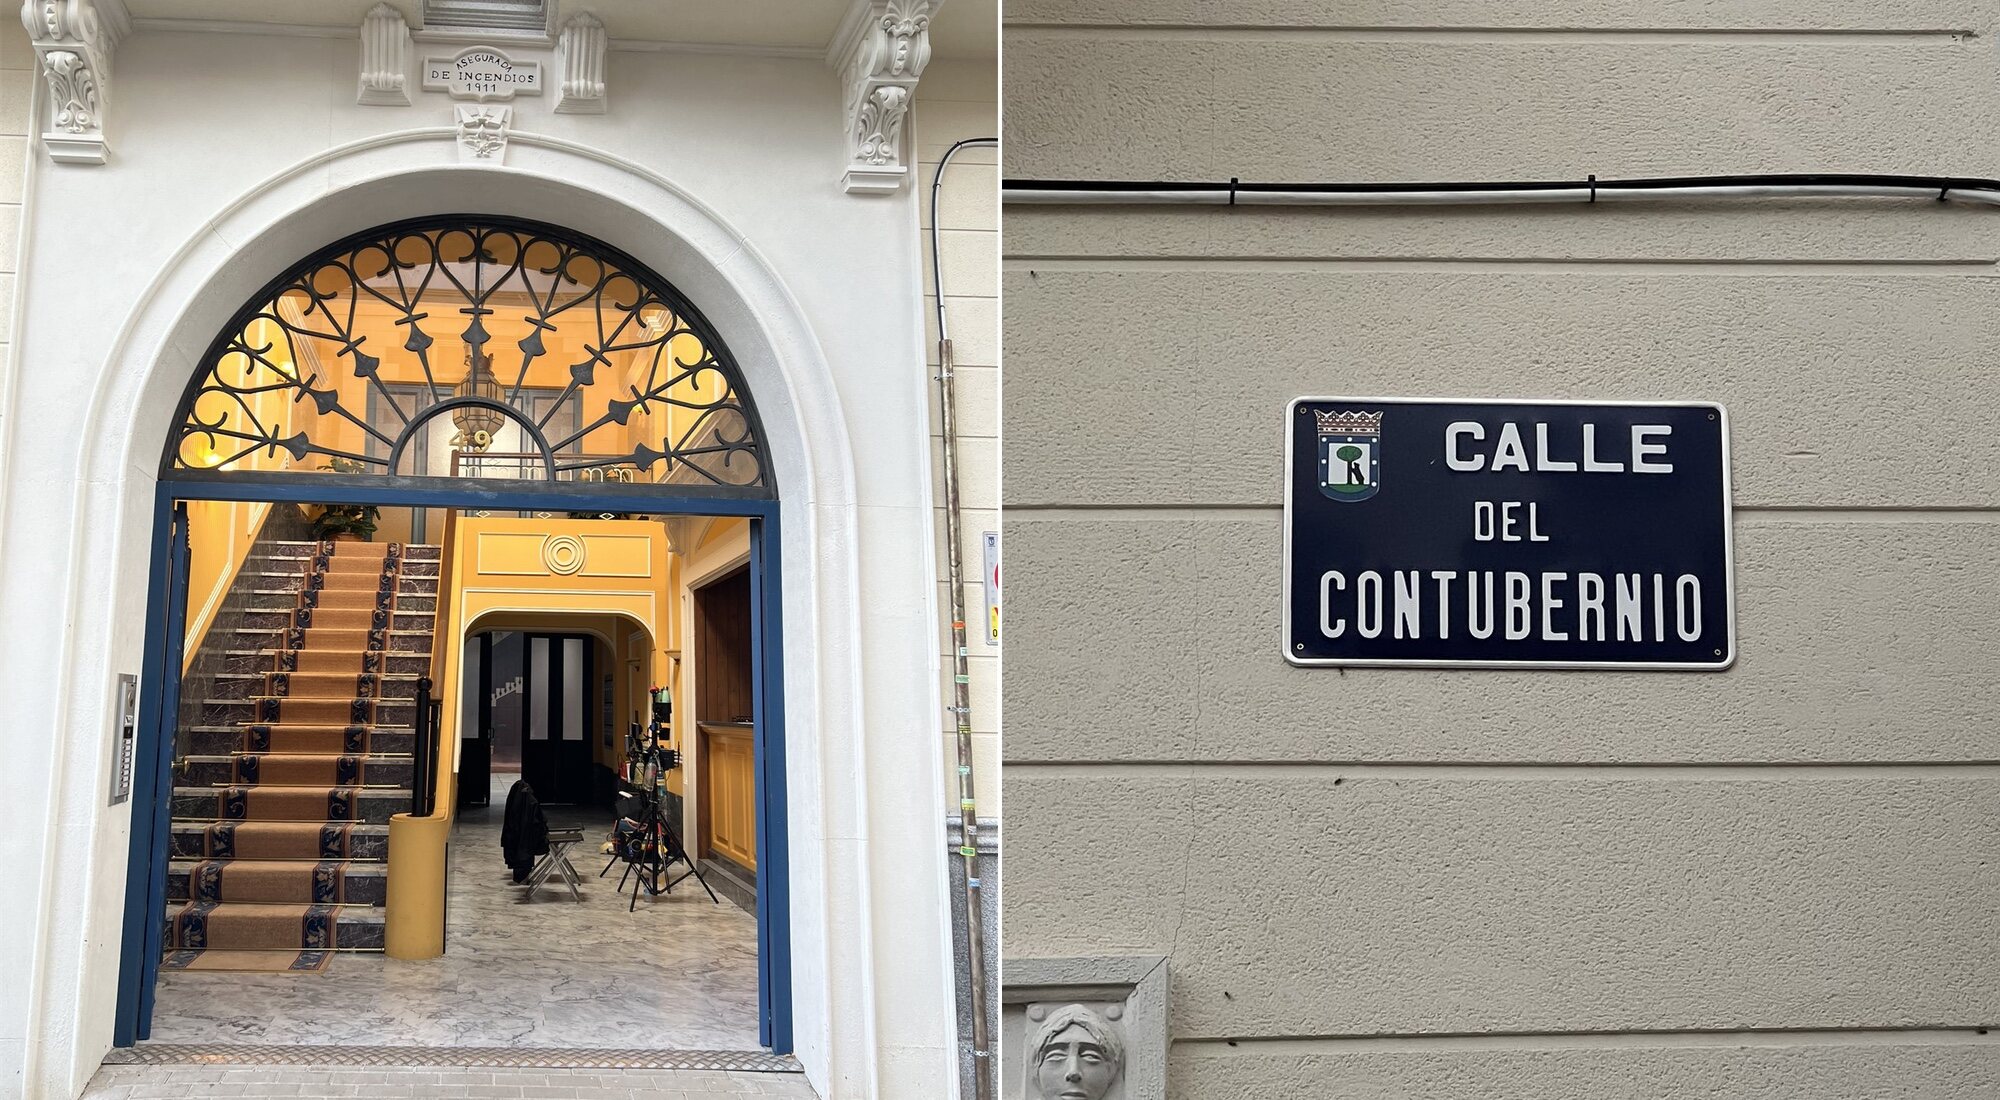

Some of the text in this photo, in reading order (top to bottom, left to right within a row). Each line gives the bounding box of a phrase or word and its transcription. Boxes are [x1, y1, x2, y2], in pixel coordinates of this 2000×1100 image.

[431, 70, 534, 83] DE INCENDIOS
[456, 54, 512, 72] ASEGURADA
[466, 83, 496, 92] 1911
[1445, 421, 1674, 474] CALLE
[1474, 501, 1550, 542] DEL
[1320, 570, 1702, 642] CONTUBERNIO
